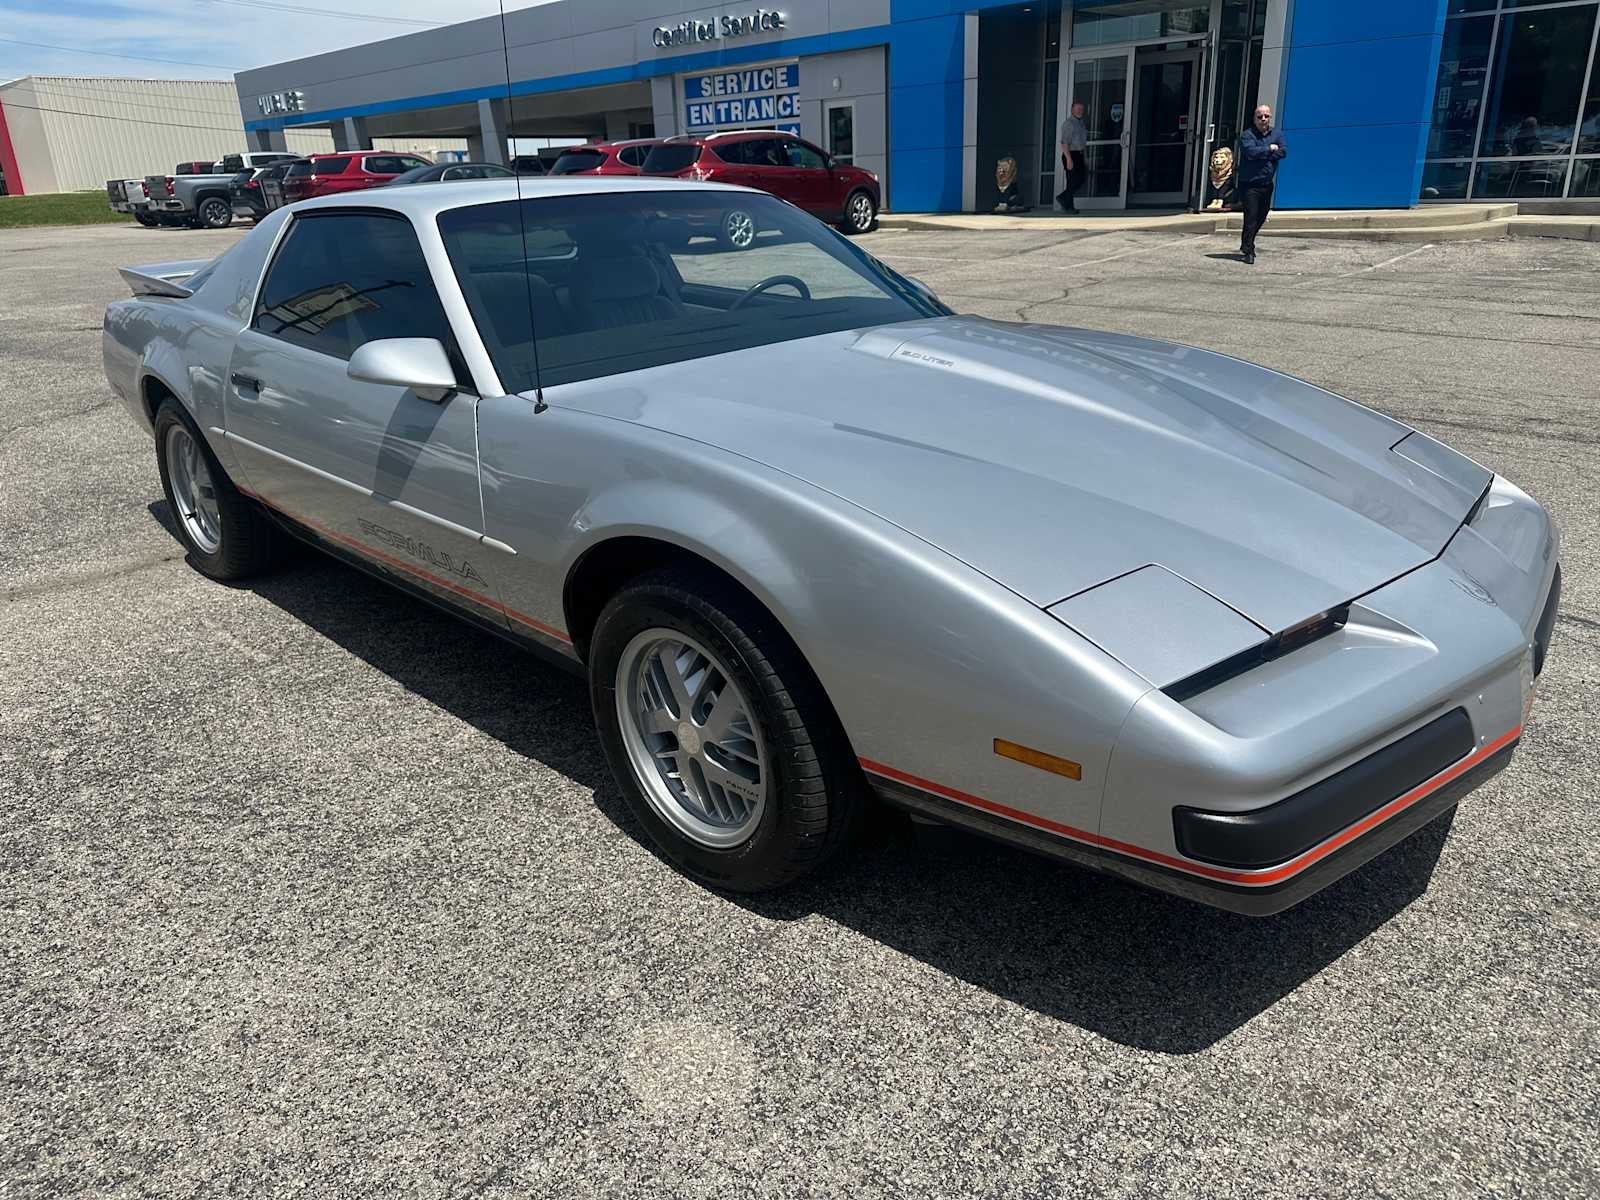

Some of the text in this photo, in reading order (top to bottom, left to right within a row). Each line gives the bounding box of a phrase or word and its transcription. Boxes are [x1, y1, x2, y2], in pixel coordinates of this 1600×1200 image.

[653, 9, 785, 47] Certified Service
[701, 67, 788, 96] SERVICE
[690, 95, 800, 125] ENTRANCE
[358, 518, 488, 587] FORMULA
